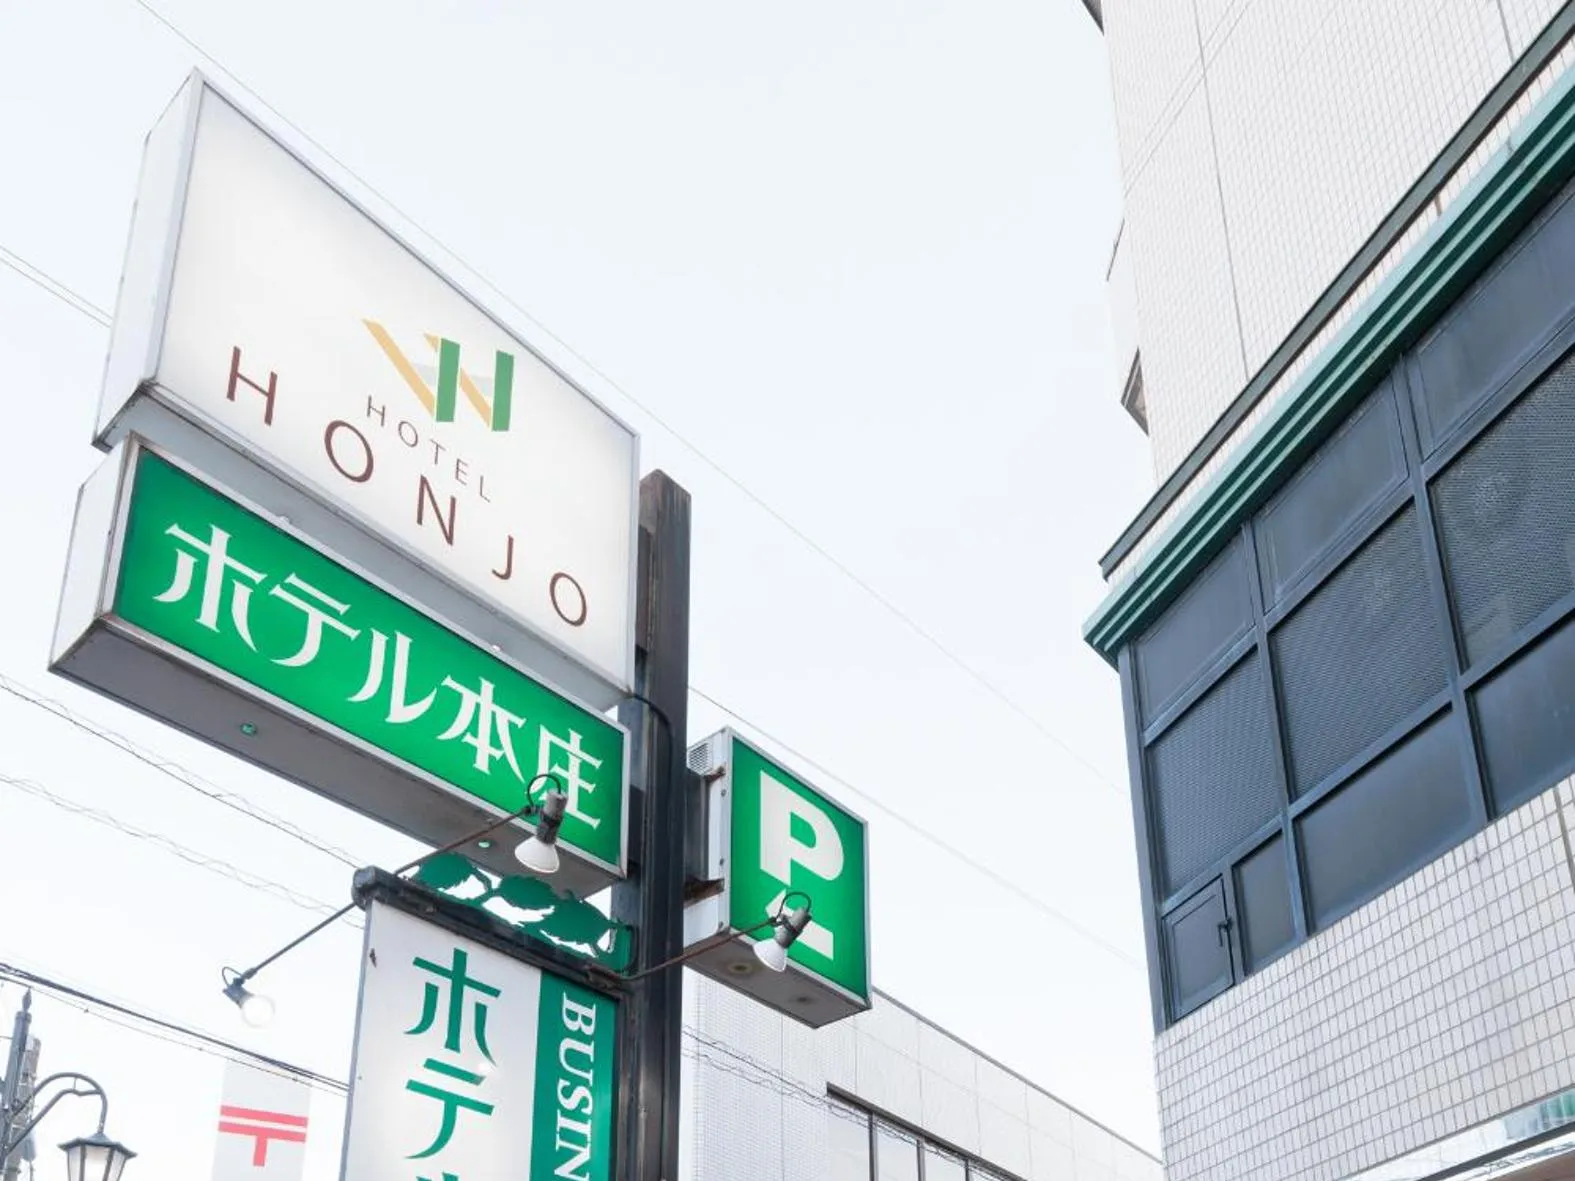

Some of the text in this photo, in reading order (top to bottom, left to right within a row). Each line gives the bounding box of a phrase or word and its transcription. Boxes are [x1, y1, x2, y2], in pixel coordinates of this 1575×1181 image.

[226, 346, 588, 627] HONJO
[366, 394, 491, 504] HOTEL
[153, 522, 604, 829] ホテル本庄
[759, 769, 844, 887] P
